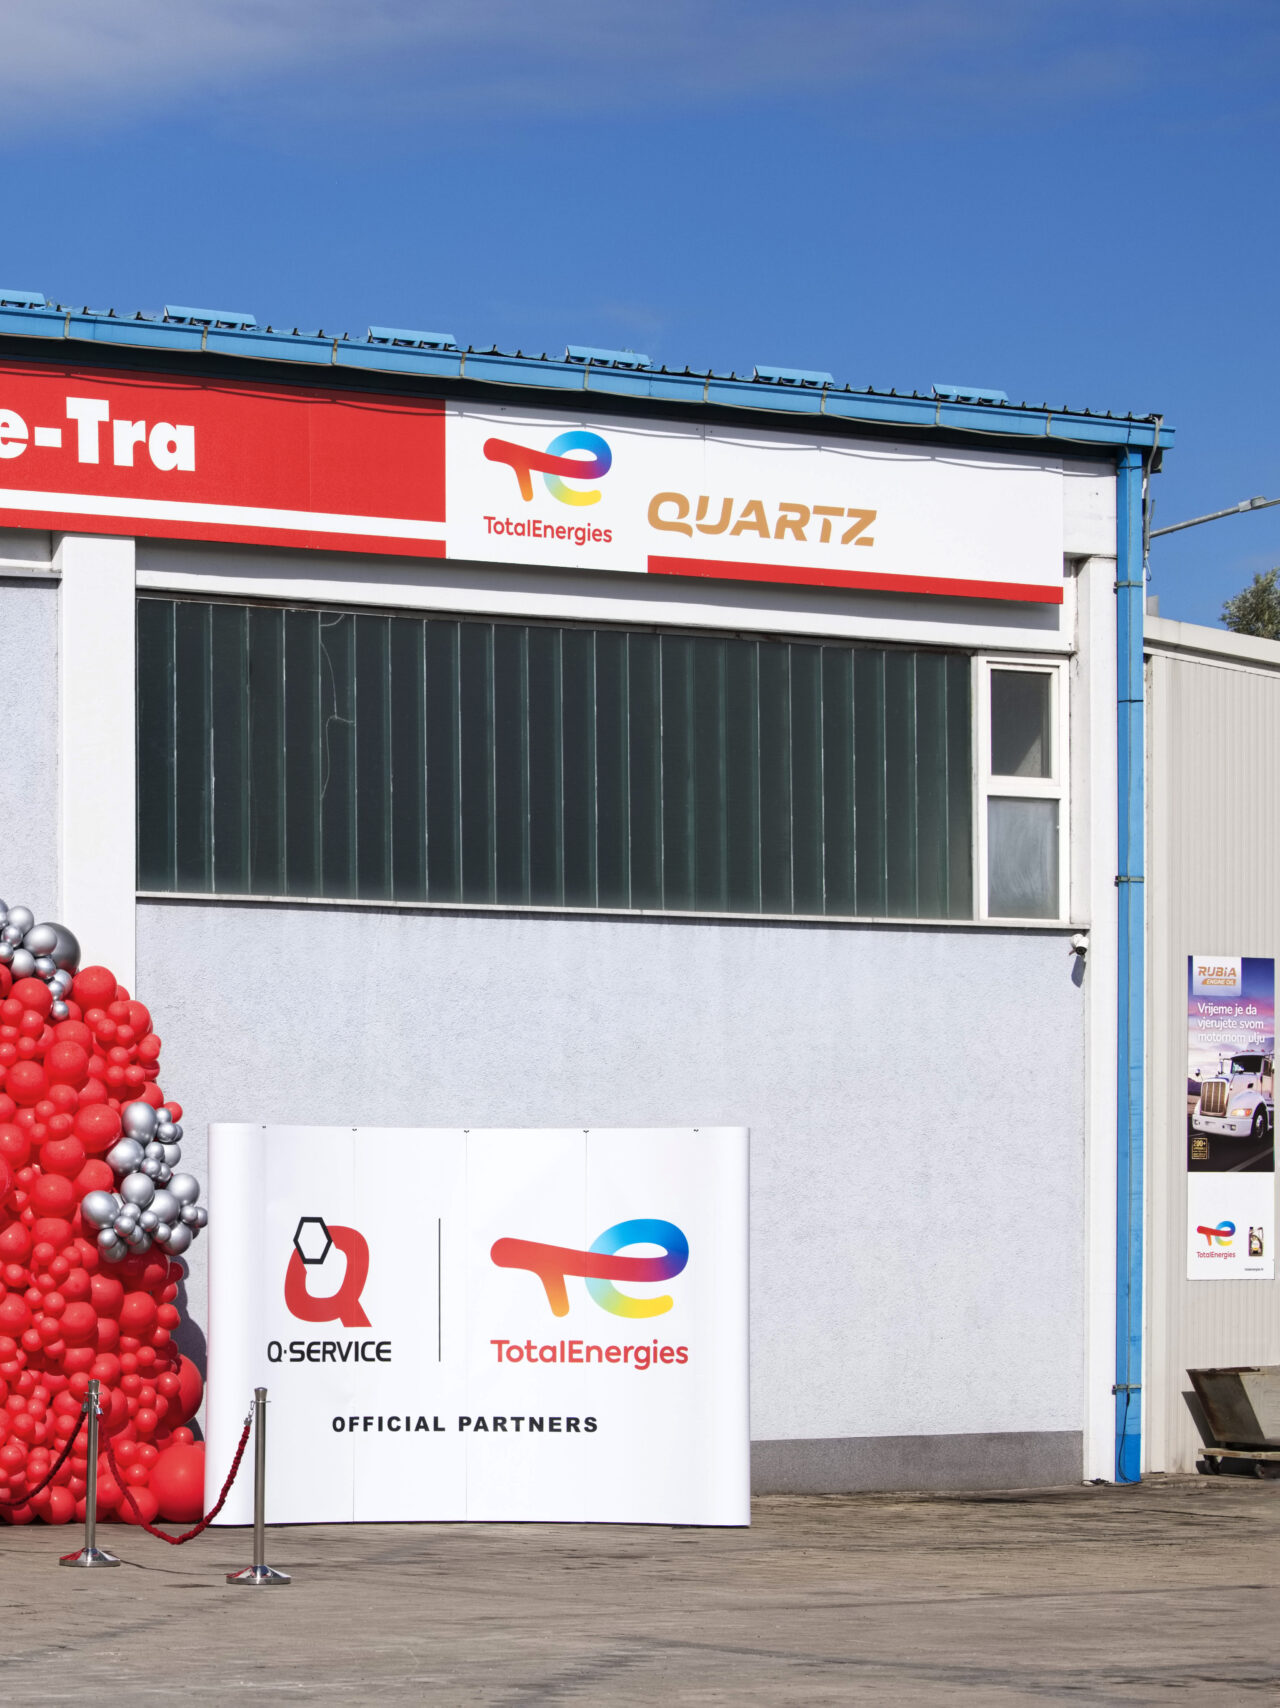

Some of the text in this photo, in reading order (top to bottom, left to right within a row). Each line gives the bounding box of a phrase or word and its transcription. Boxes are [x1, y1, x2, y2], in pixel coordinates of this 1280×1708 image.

[647, 491, 877, 547] QUARTZ
[483, 515, 613, 546] TotalEnergies
[1197, 1002, 1257, 1017] Vrijeme je da
[1198, 1016, 1264, 1030] vjerujete svom
[1198, 1031, 1266, 1045] motornom ulju
[1196, 1251, 1236, 1259] TotalEnergies
[490, 1339, 689, 1371] TotalEnergies
[332, 1415, 599, 1433] OFFICIAL PARTNERS
